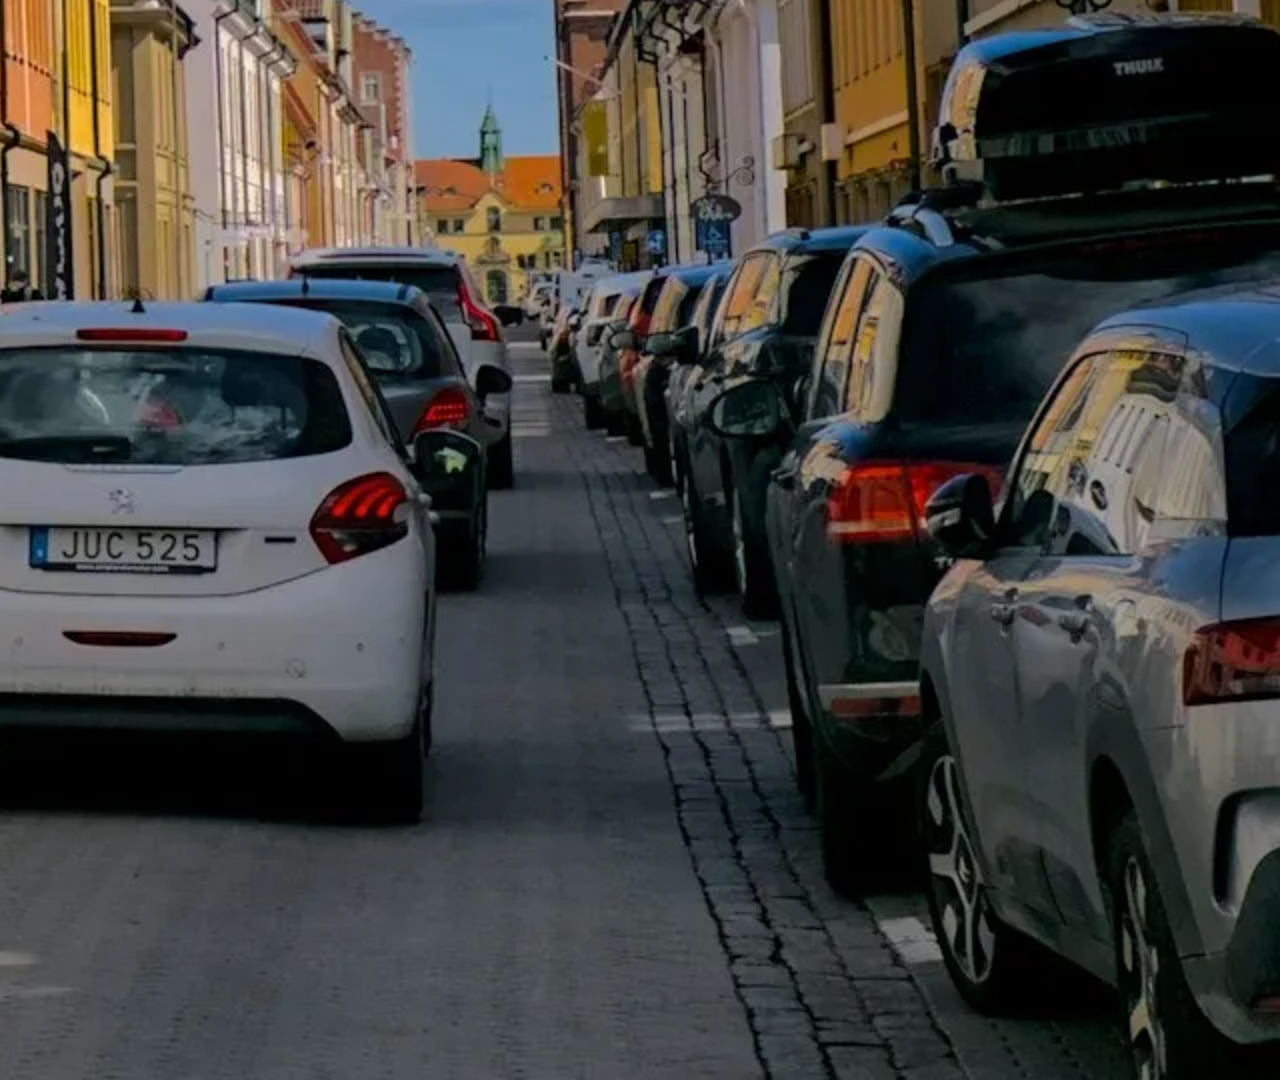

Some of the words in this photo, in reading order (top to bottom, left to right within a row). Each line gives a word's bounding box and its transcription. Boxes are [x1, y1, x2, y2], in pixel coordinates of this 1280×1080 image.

[1113, 57, 1165, 76] THULE
[61, 531, 124, 561] JUC
[137, 532, 202, 562] 525
